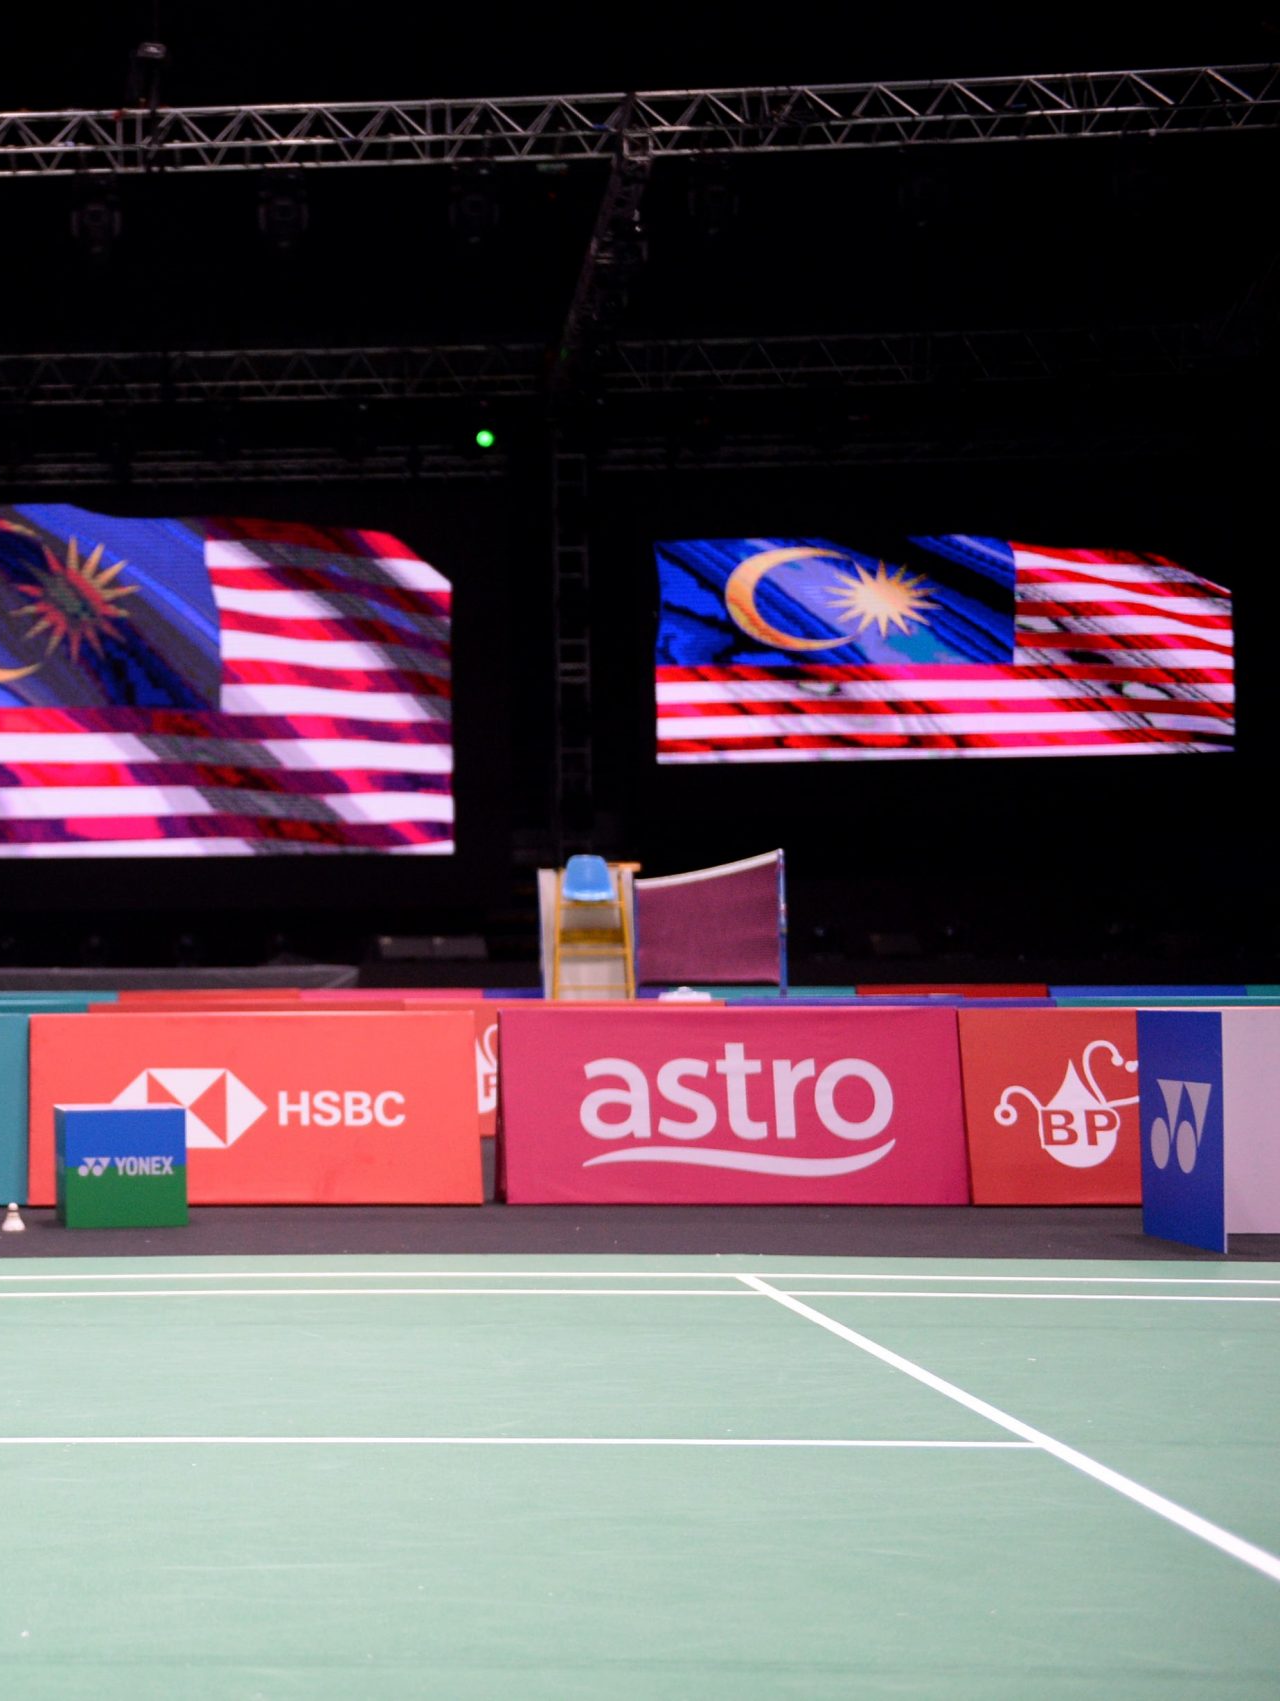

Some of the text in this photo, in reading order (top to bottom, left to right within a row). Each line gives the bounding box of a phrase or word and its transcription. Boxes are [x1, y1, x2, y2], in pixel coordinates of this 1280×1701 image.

[277, 1090, 407, 1128] HSBC
[579, 1042, 895, 1141] astro
[1041, 1109, 1118, 1146] BP
[114, 1155, 174, 1176] YONEX
